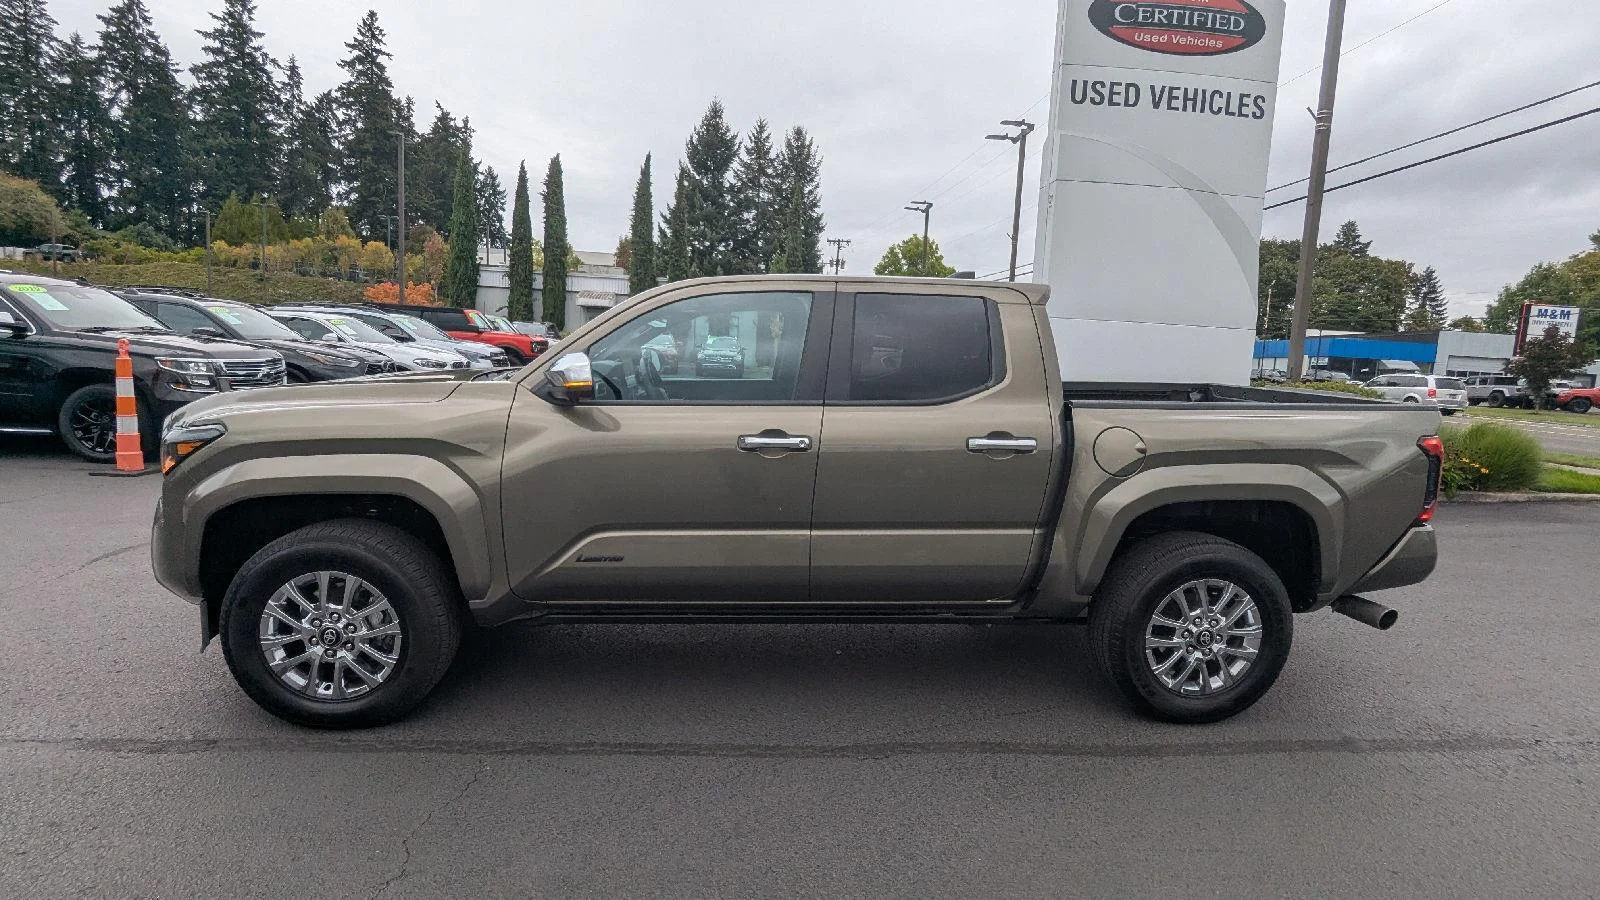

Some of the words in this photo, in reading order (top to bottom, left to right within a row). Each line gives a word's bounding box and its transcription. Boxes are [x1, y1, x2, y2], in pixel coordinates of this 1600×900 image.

[1114, 3, 1245, 32] CERTIFIED
[1134, 32, 1168, 43] Used
[1171, 34, 1224, 48] Vehicles
[1070, 79, 1141, 108] USED
[1149, 84, 1266, 120] VEHICLES
[1537, 308, 1572, 320] M&M
